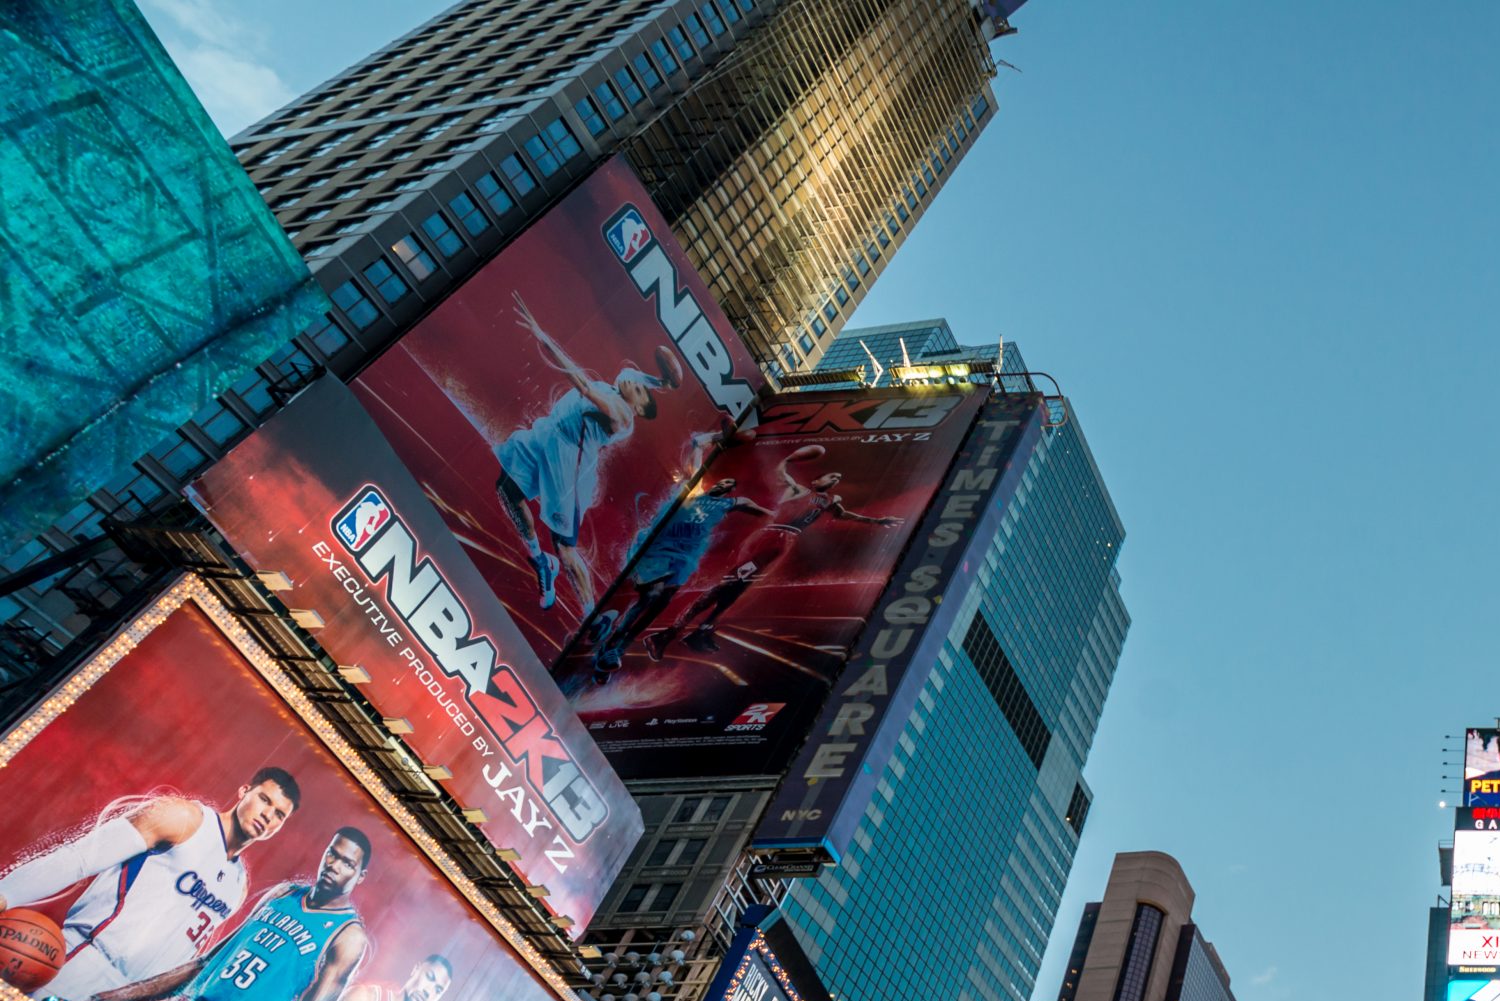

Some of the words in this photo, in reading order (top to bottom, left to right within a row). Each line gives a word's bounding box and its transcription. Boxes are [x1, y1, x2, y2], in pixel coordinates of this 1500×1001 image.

[631, 256, 760, 429] NBA
[760, 395, 963, 433] 2K13
[860, 432, 909, 443] JAY
[912, 432, 933, 441] Z
[928, 420, 1020, 548] TIMES
[340, 521, 358, 544] NBA
[311, 540, 403, 648] EXECUTIVE
[803, 564, 942, 779] SQUARE
[400, 646, 476, 738] PRODUCED
[724, 723, 767, 732] SPORTS
[741, 703, 775, 723] 2K
[471, 735, 494, 758] BY
[482, 762, 554, 839] JAY
[780, 808, 823, 824] NYC
[544, 838, 576, 874] Z
[253, 928, 286, 954] CITY
[219, 950, 267, 990] 35
